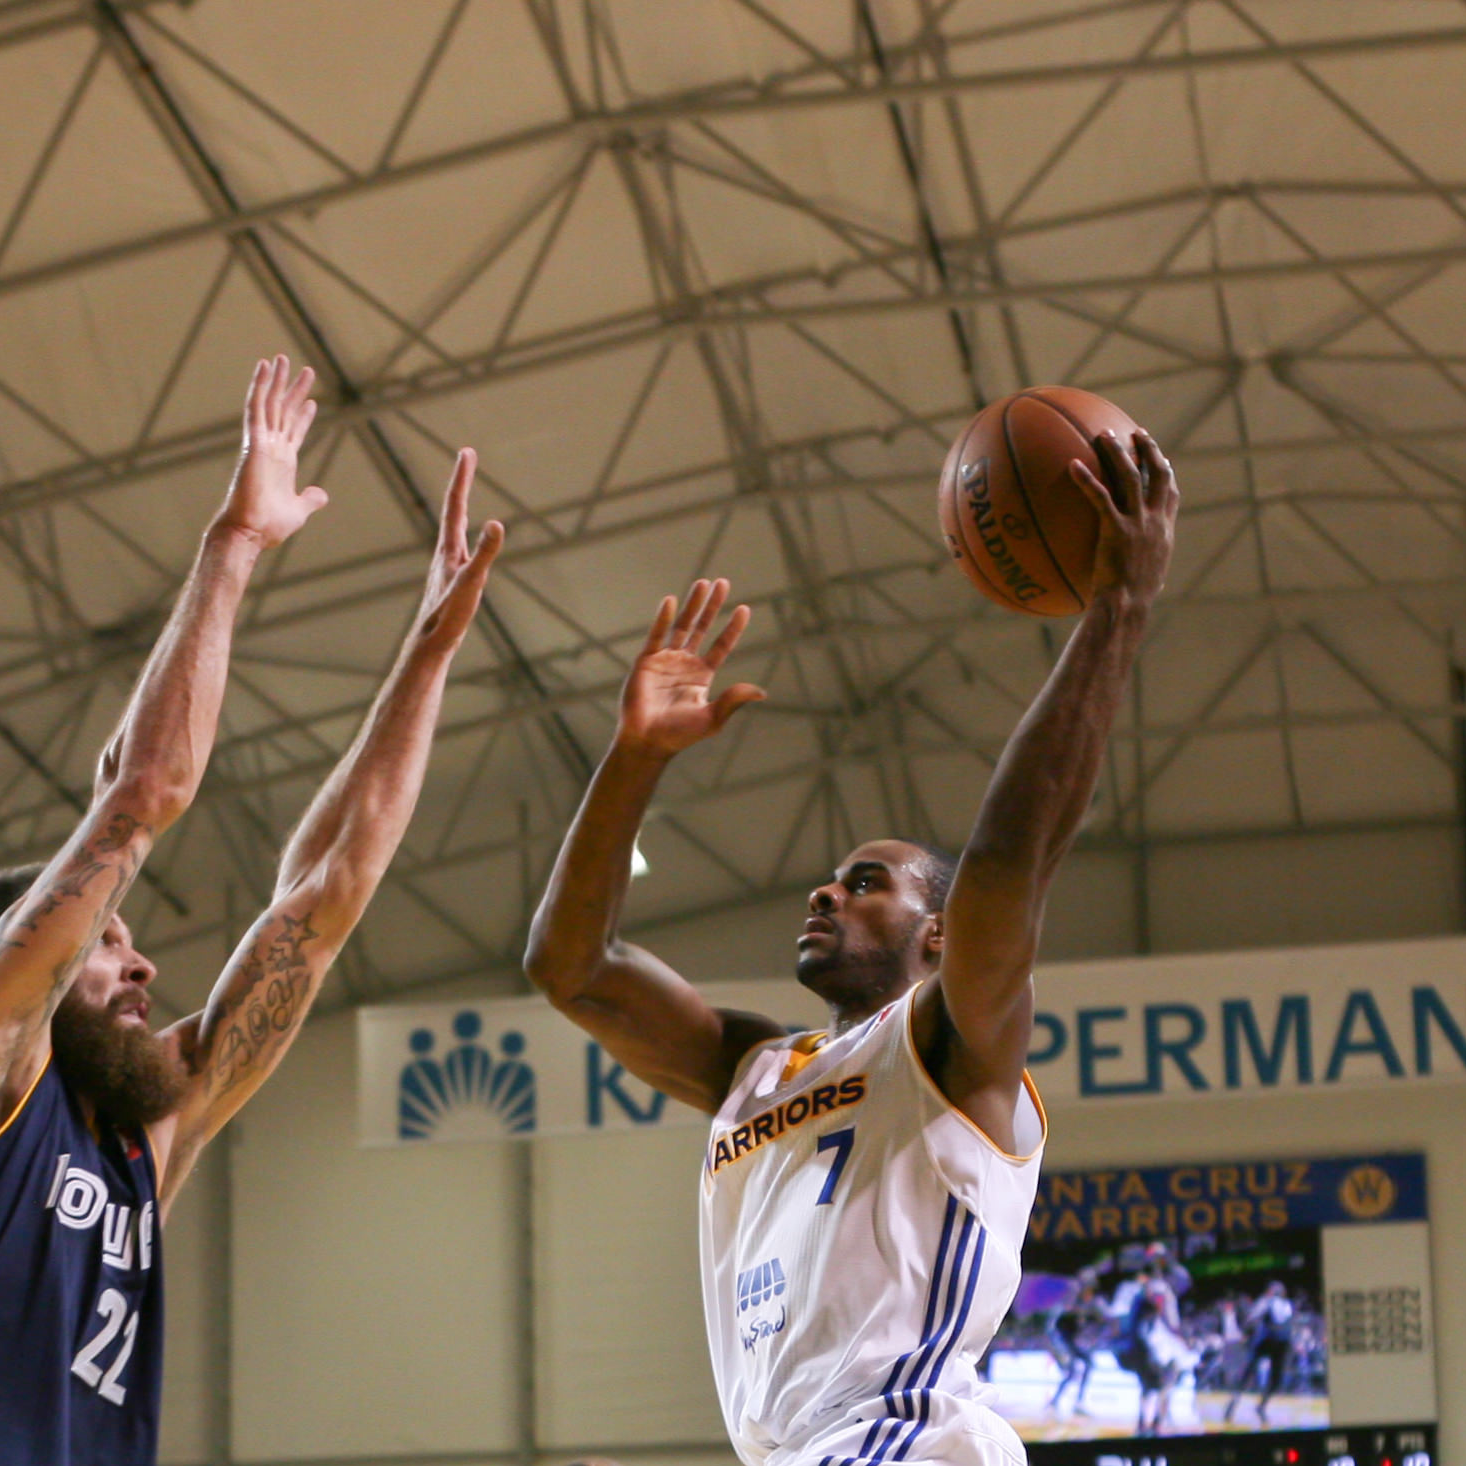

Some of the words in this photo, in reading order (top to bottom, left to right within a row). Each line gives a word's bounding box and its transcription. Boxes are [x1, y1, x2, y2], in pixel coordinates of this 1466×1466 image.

[961, 455, 1048, 603] SPALDING
[705, 1073, 869, 1178] ARRIORS
[816, 1126, 857, 1206] 7
[1170, 1163, 1312, 1198] CRUZ
[71, 1288, 140, 1408] 22
